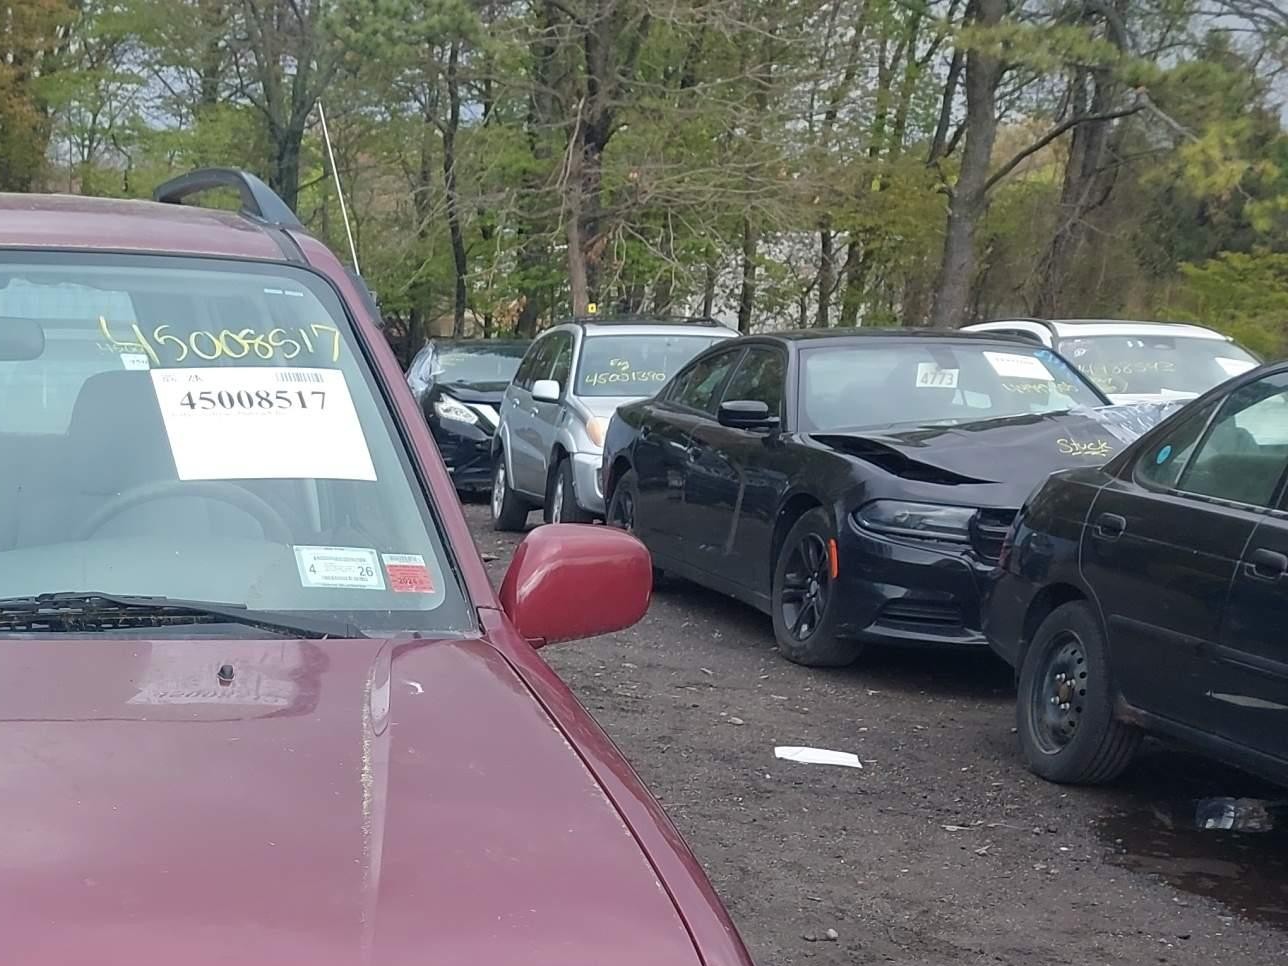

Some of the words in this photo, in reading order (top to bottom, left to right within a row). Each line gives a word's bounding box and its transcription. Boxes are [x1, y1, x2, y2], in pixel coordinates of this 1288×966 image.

[99, 314, 341, 366] 45008517
[920, 373, 954, 386] 4773
[179, 389, 327, 411] 45008517
[1056, 437, 1113, 454] Stuck
[308, 563, 317, 575] 4
[357, 566, 374, 577] 26
